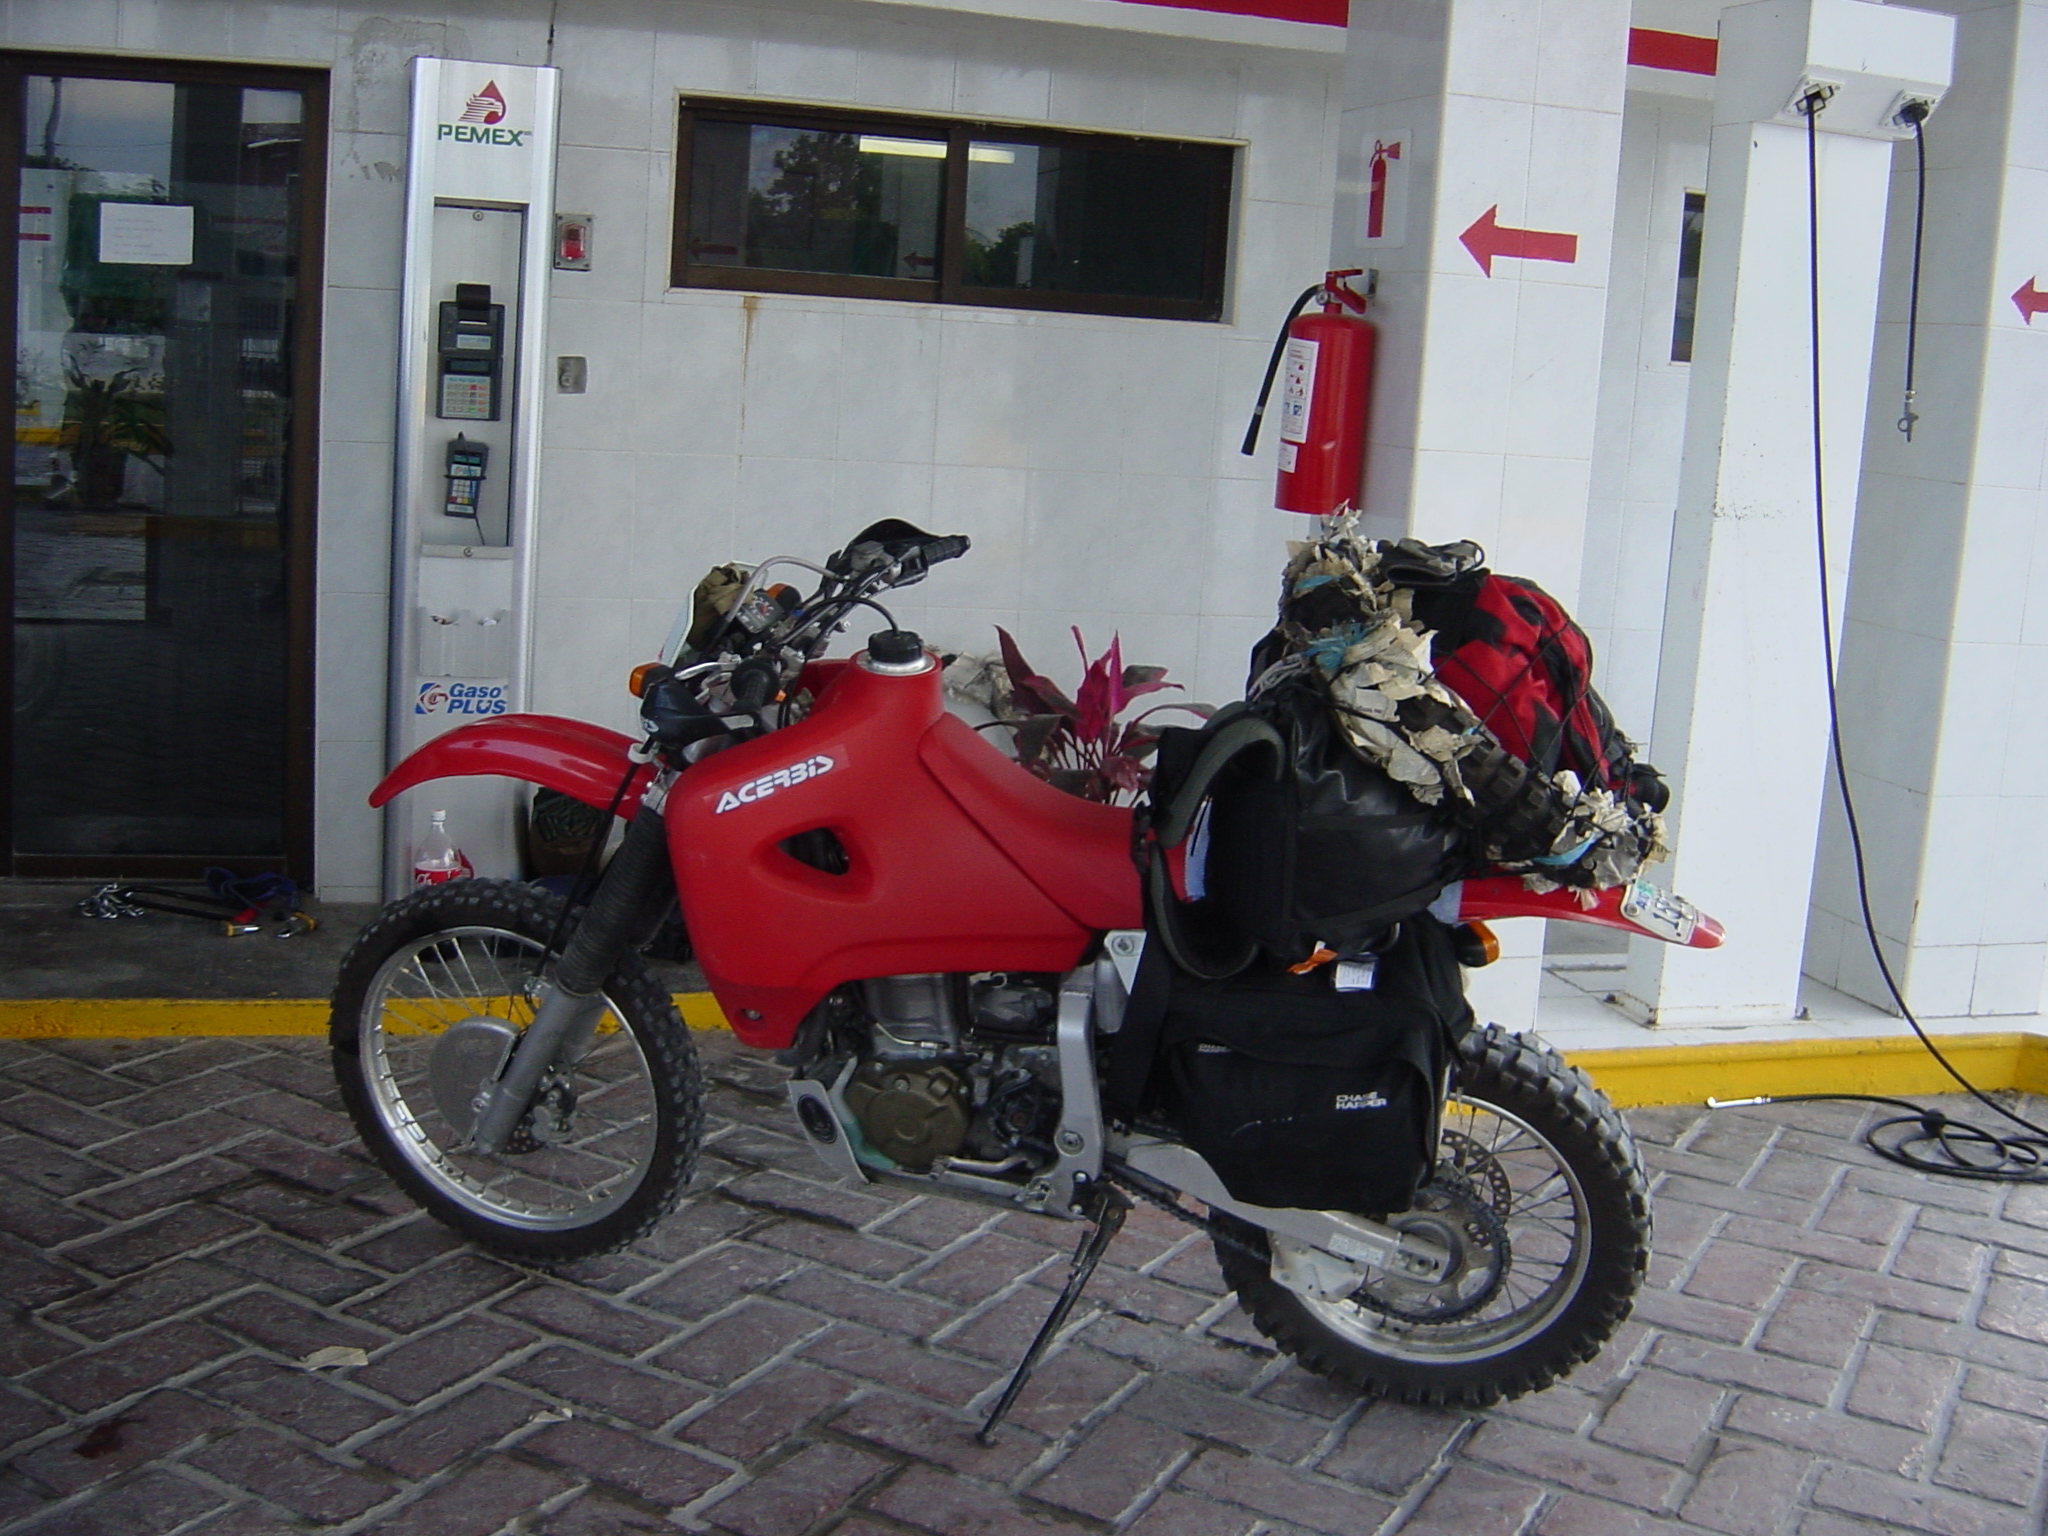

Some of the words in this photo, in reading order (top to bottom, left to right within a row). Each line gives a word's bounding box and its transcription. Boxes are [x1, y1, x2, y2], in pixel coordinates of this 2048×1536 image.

[438, 124, 524, 147] PEMEX
[449, 683, 502, 699] Gaso
[447, 699, 507, 715] PLUS
[1335, 1091, 1378, 1102] CHASE
[1335, 1098, 1387, 1110] HARPER
